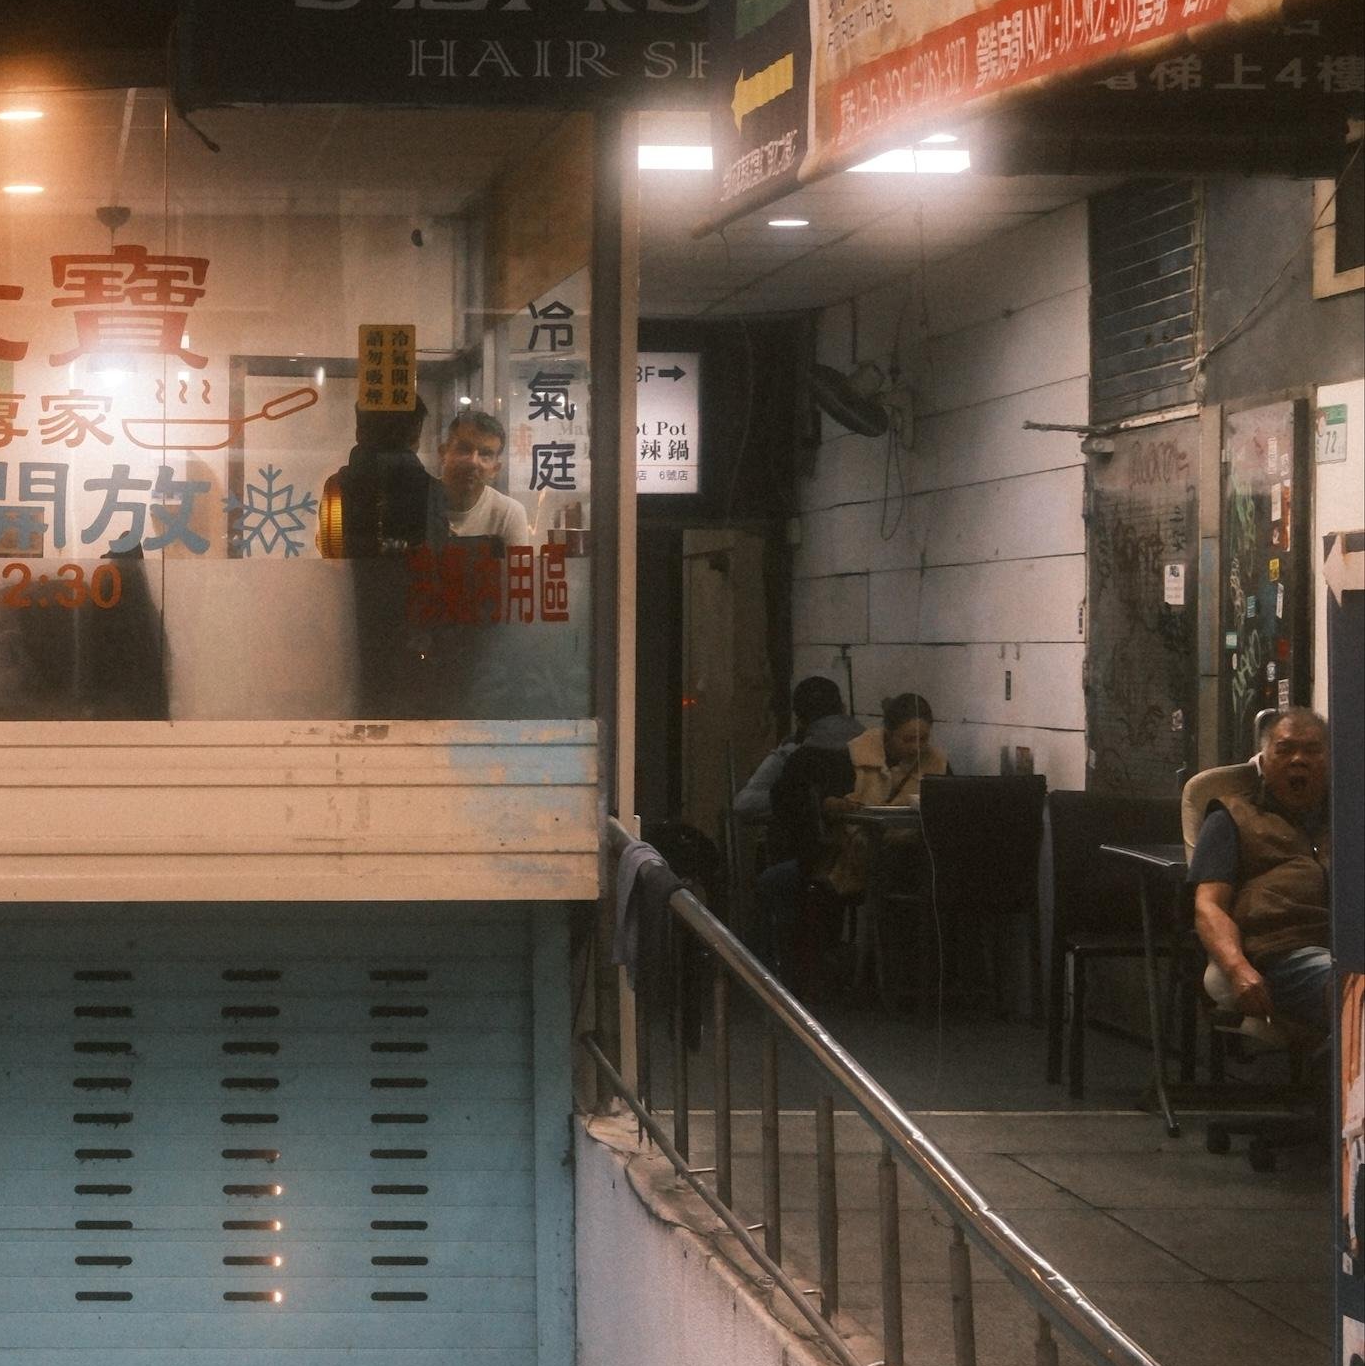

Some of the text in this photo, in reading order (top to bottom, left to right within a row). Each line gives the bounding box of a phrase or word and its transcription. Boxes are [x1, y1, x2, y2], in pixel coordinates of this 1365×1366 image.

[408, 38, 621, 79] HAIR
[527, 300, 577, 492] 冷氣庭
[657, 422, 687, 436] Pot
